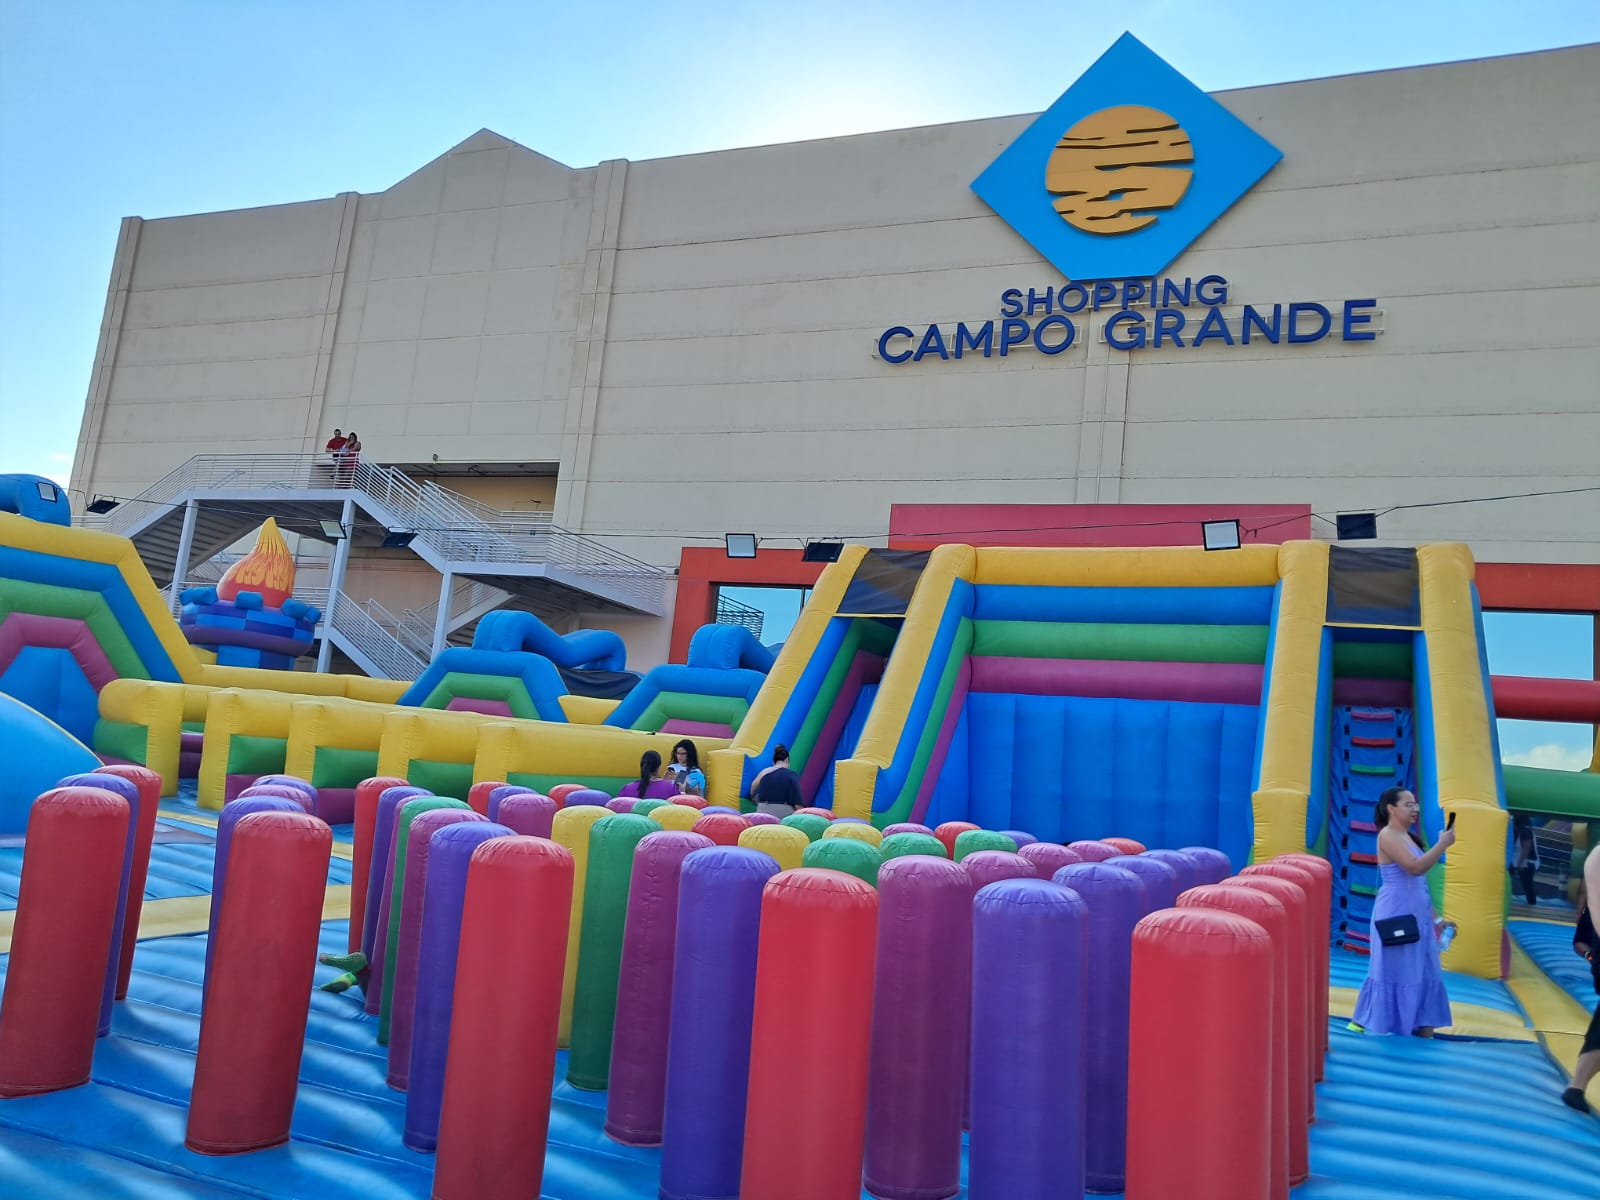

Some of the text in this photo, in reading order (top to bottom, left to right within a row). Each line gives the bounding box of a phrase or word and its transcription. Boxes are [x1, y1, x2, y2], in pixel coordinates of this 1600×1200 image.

[1000, 274, 1229, 318] SHOPPING
[878, 298, 1378, 364] CAMPO GRANDE
